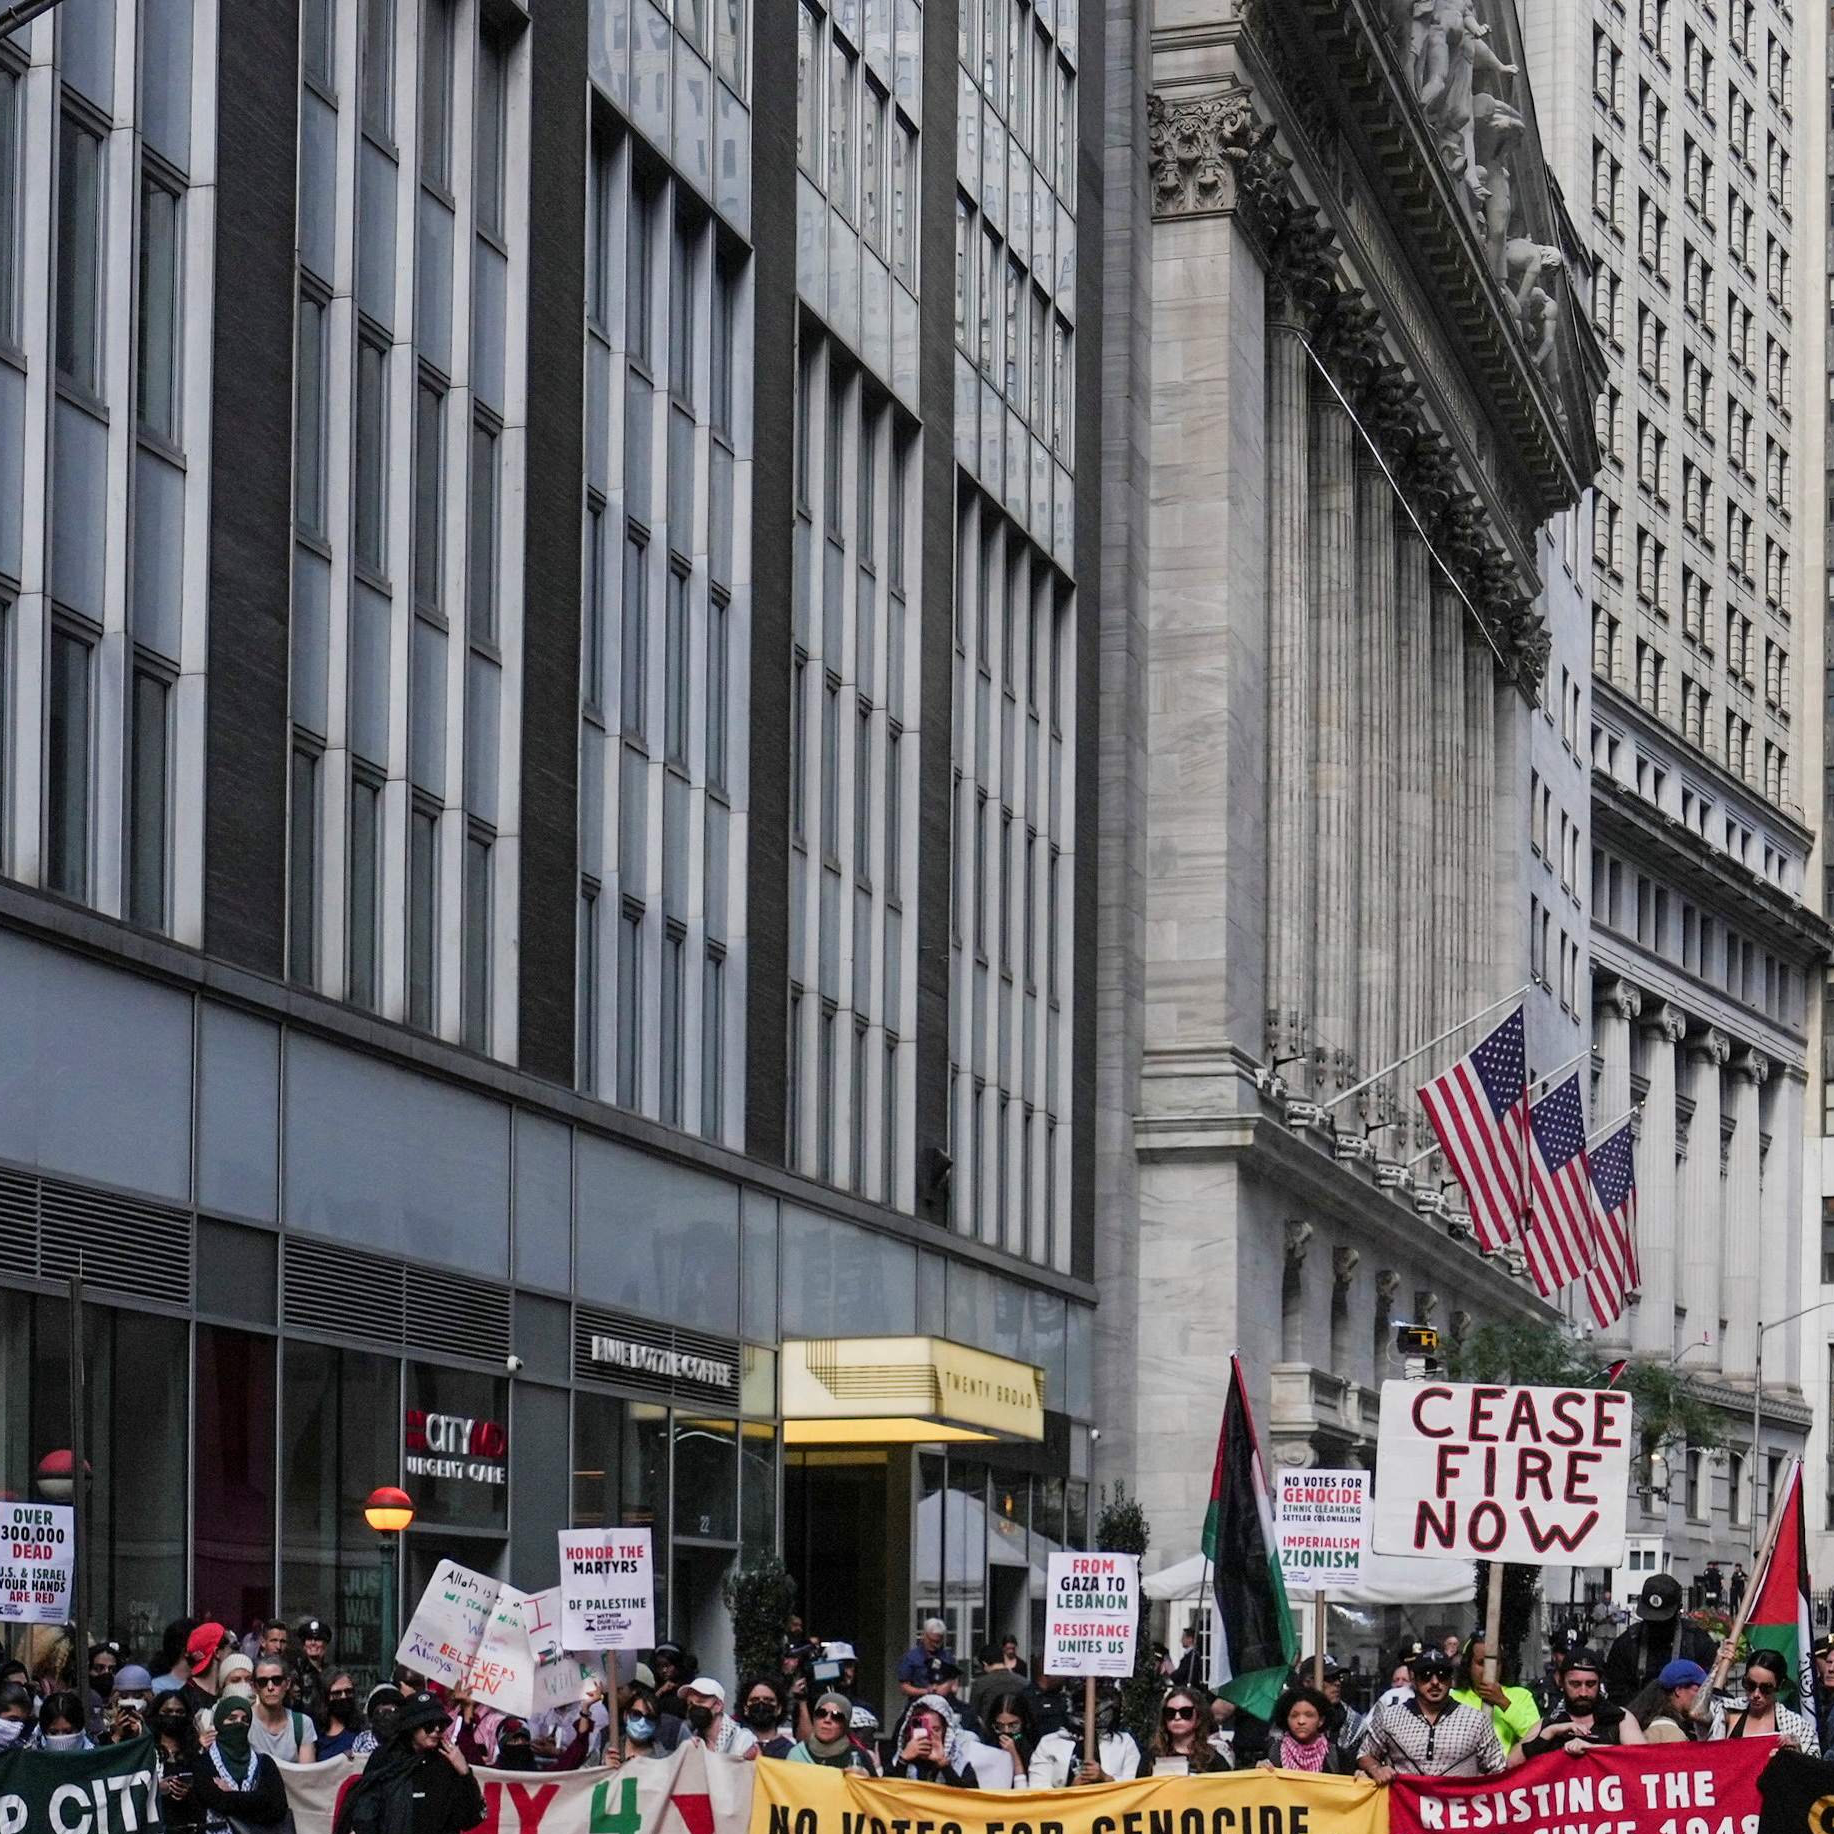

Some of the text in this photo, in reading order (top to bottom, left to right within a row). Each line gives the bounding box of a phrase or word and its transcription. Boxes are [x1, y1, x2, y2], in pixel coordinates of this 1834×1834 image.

[946, 1371, 1032, 1409] TWENTY BROAD
[1410, 1386, 1627, 1451] CEASE
[406, 1455, 507, 1486] URGENT CARE
[1435, 1443, 1604, 1505] FIRE
[1284, 1476, 1362, 1488] NO VOTES FOR
[1283, 1488, 1362, 1504] GENOCIDE
[13, 1508, 53, 1526] OVER
[1282, 1504, 1362, 1515] ETHNIC CLEANSING
[1282, 1513, 1362, 1523] SETTLER COLONIALISM
[1, 1525, 65, 1544] 300,000
[1414, 1501, 1600, 1555] NOW
[1282, 1536, 1360, 1550] IMPERIALISM
[13, 1543, 53, 1560] DEAD
[566, 1545, 644, 1560] HONOR THE
[1282, 1549, 1360, 1569] ZIONISM
[20, 1567, 28, 1578] &
[33, 1568, 66, 1580] ISRAEL
[573, 1560, 638, 1575] MARTYRS
[1072, 1558, 1115, 1574] FROM
[32, 1580, 66, 1593] HANDS
[1060, 1576, 1125, 1592] GAZA TO
[9, 1590, 55, 1604] ARE RED
[569, 1597, 647, 1611] OF PALESTINE
[1056, 1593, 1128, 1610] LEBANON
[1053, 1623, 1130, 1638] RESISTANCE
[1057, 1640, 1124, 1654] UNITES US
[1420, 1770, 1716, 1830] RESISTING THE
